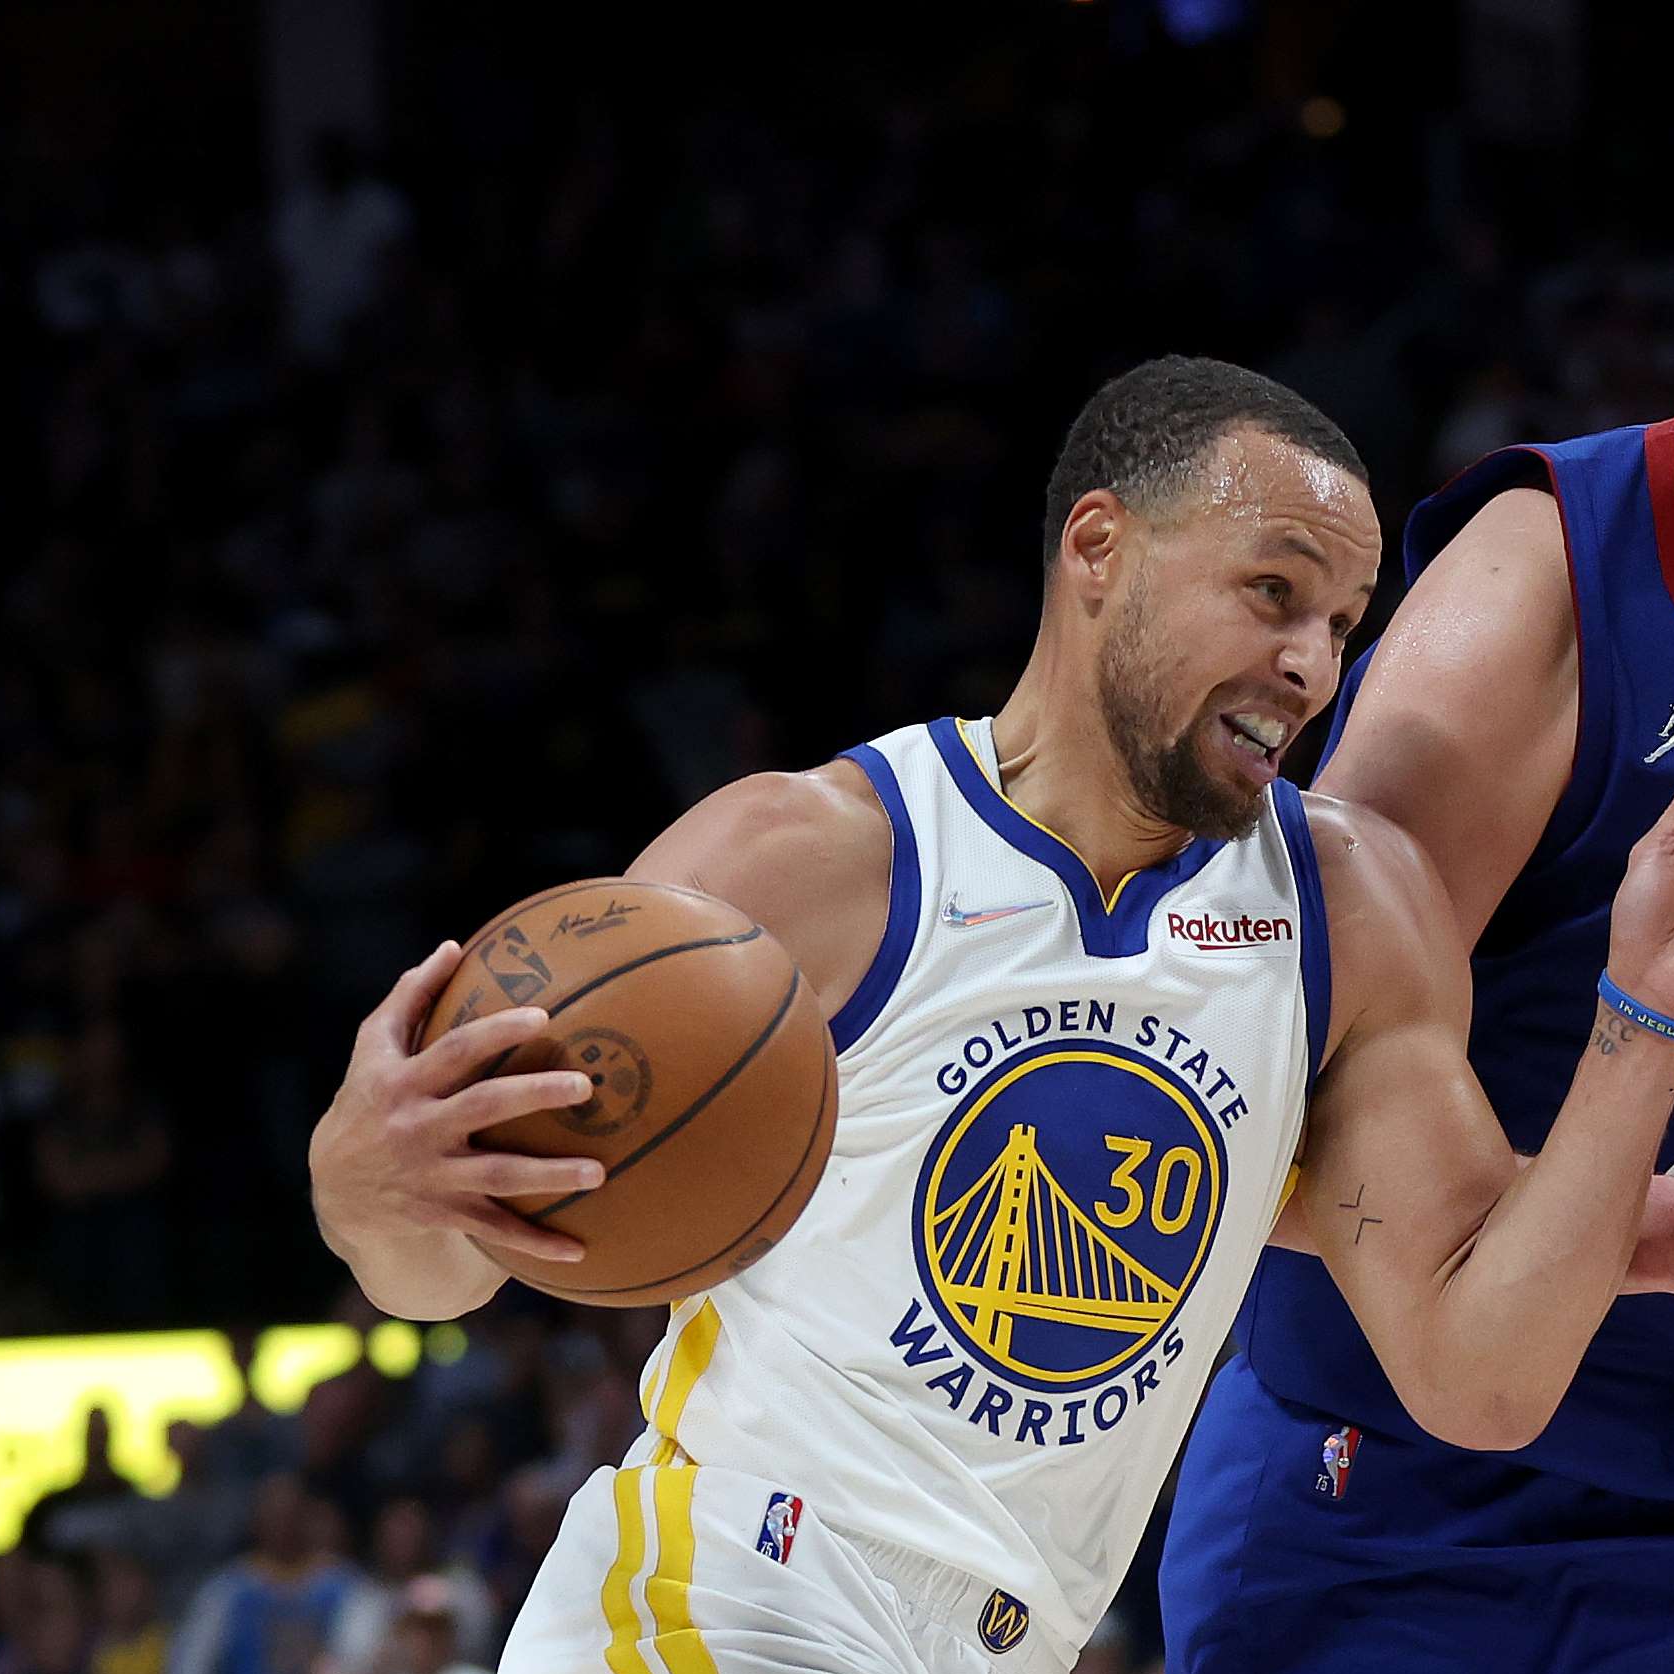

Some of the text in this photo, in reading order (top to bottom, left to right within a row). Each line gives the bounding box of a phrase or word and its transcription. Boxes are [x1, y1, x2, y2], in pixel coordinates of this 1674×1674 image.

[1167, 912, 1293, 943] Rakuten
[1619, 1000, 1634, 1016] IN
[936, 999, 1248, 1130] GOLDEN STATE
[1094, 1133, 1203, 1235] 30
[889, 1297, 1184, 1447] WARRIORS
